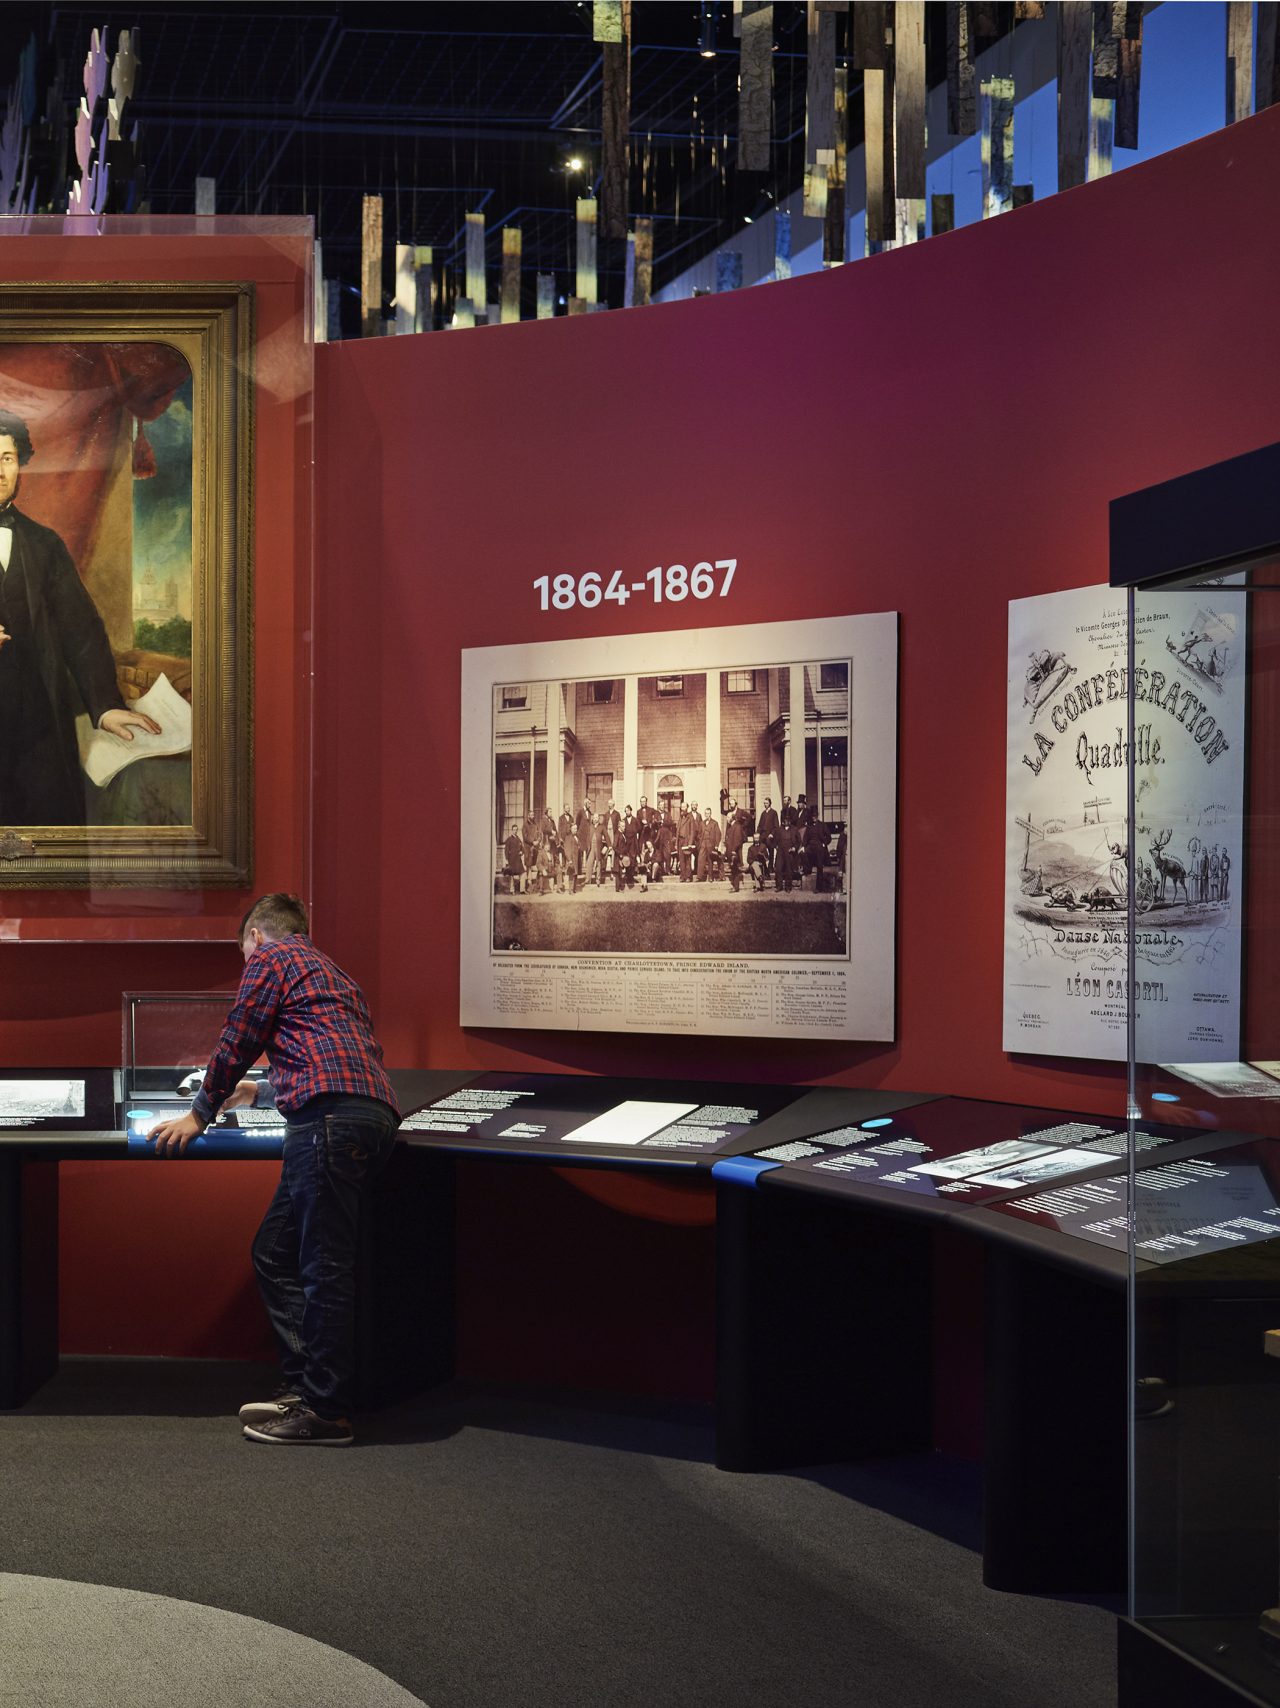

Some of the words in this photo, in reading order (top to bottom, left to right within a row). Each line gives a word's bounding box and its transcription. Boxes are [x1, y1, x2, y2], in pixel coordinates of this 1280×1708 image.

[533, 558, 738, 611] 1864-1867
[1022, 732, 1055, 777] LA
[1075, 723, 1165, 786] Quadrlle.
[1066, 971, 1101, 998] LÉON
